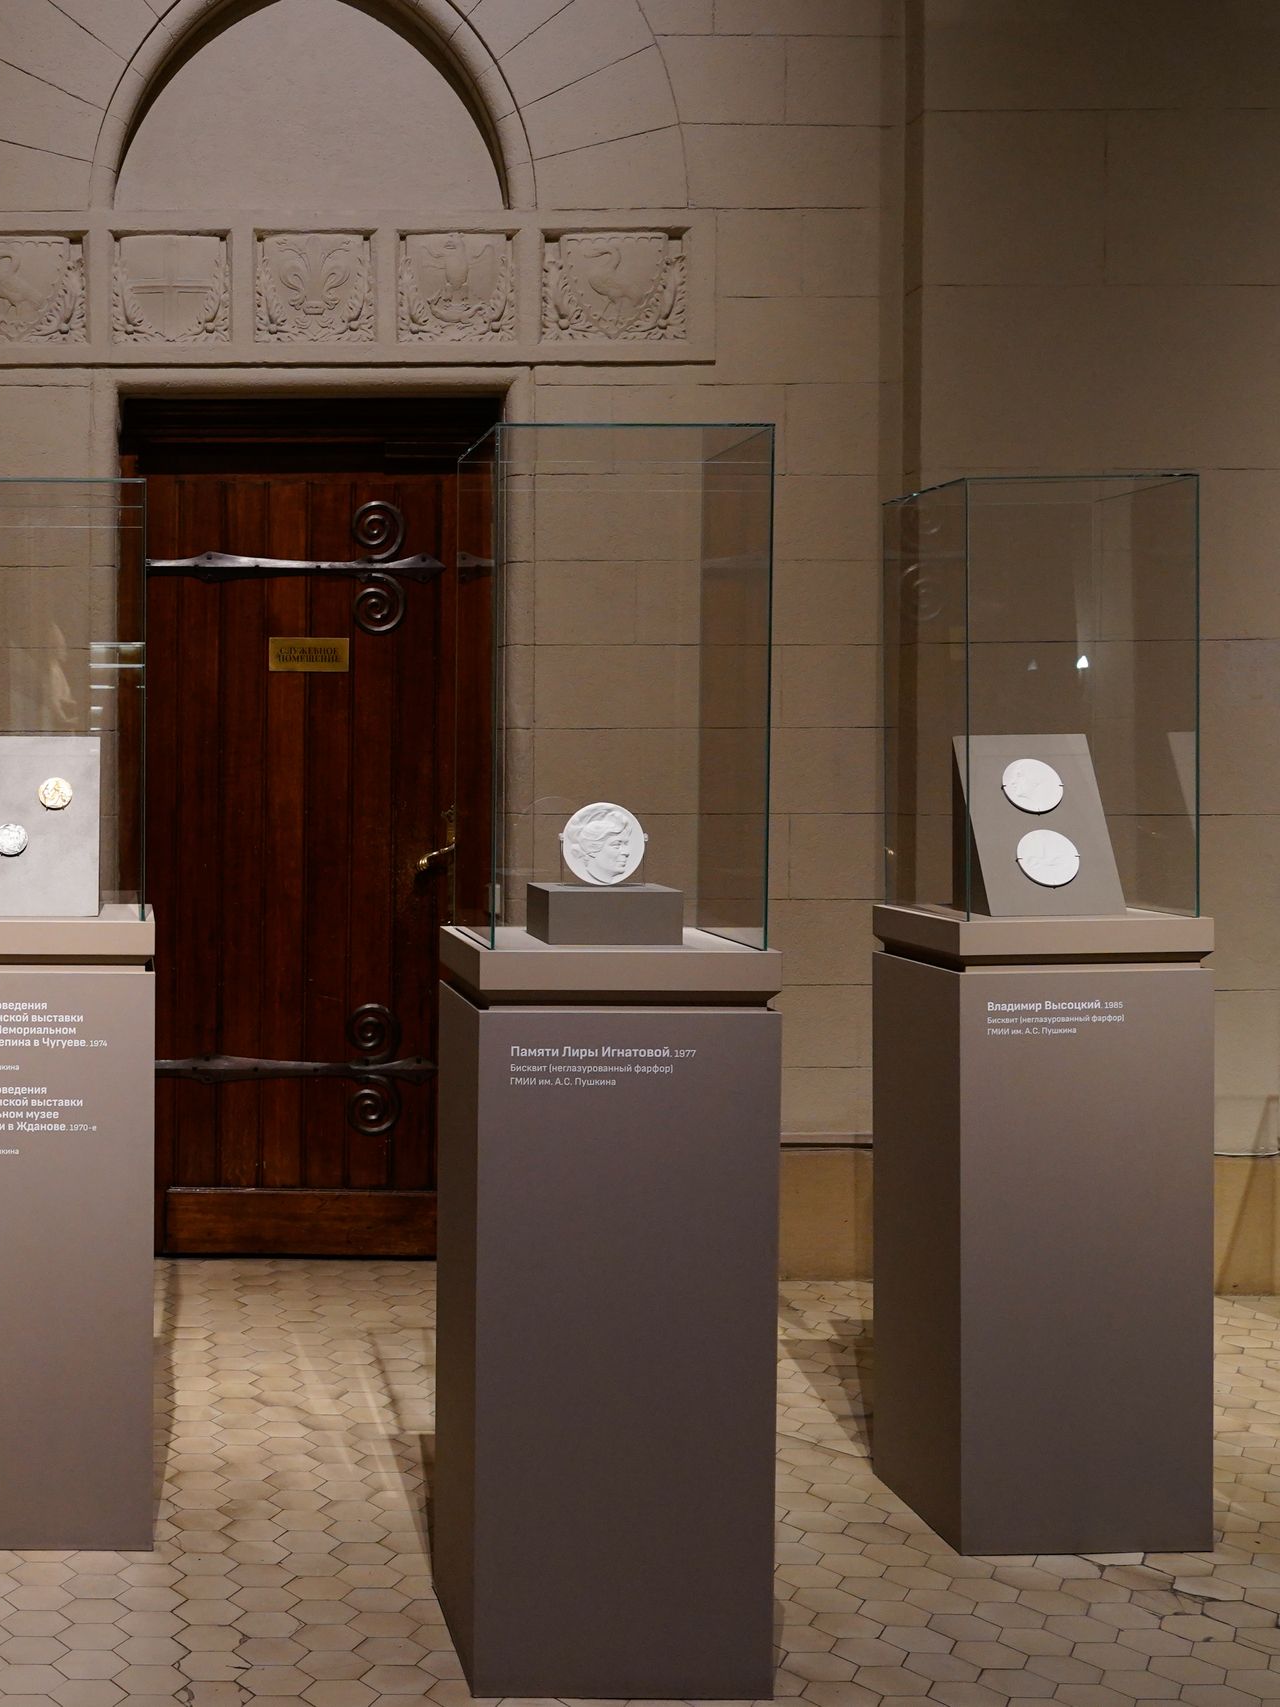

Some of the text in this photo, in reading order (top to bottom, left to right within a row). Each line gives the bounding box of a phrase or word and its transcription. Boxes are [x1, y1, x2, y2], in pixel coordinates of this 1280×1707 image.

[987, 1002, 1041, 1012] Владимир
[31, 1014, 83, 1022] выставки
[1020, 1015, 1090, 1023] (неглазурованный
[1091, 1014, 1124, 1022] фарфор)
[34, 1039, 39, 1047] в
[511, 1046, 559, 1057] Памяти
[562, 1047, 598, 1059] Лиры
[674, 1049, 696, 1058] 1977
[510, 1064, 673, 1074] Бисквит (неглазурованный фарфор)
[575, 1078, 616, 1087] Пушкина
[26, 1111, 59, 1120] музее
[8, 1123, 14, 1131] в
